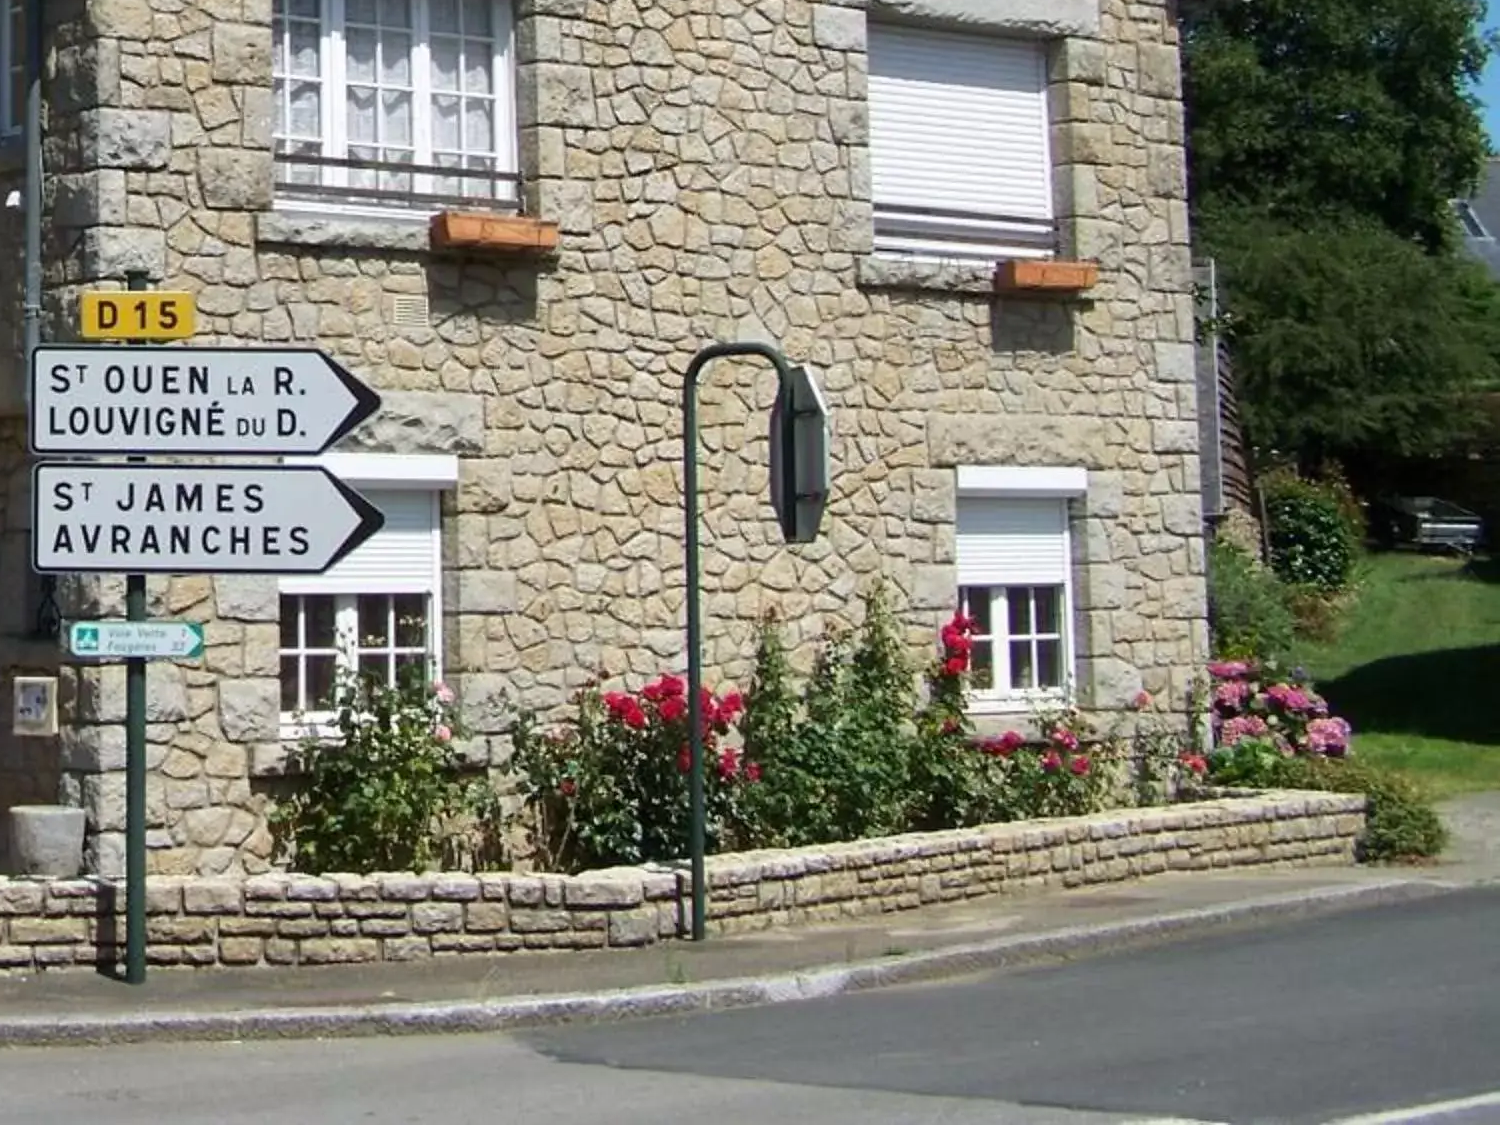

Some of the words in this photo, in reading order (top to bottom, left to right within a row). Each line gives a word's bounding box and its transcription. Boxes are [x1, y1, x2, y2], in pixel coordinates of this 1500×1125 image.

[98, 302, 118, 329] D
[133, 301, 178, 329] 15
[104, 366, 210, 395] OUEN
[227, 377, 255, 396] LA
[274, 367, 306, 396] R.
[49, 401, 225, 437] LOUVIGNÉ
[237, 418, 266, 437] DU
[277, 409, 307, 437] D.
[117, 483, 265, 513] JAMES
[53, 525, 309, 556] AVRANCHES
